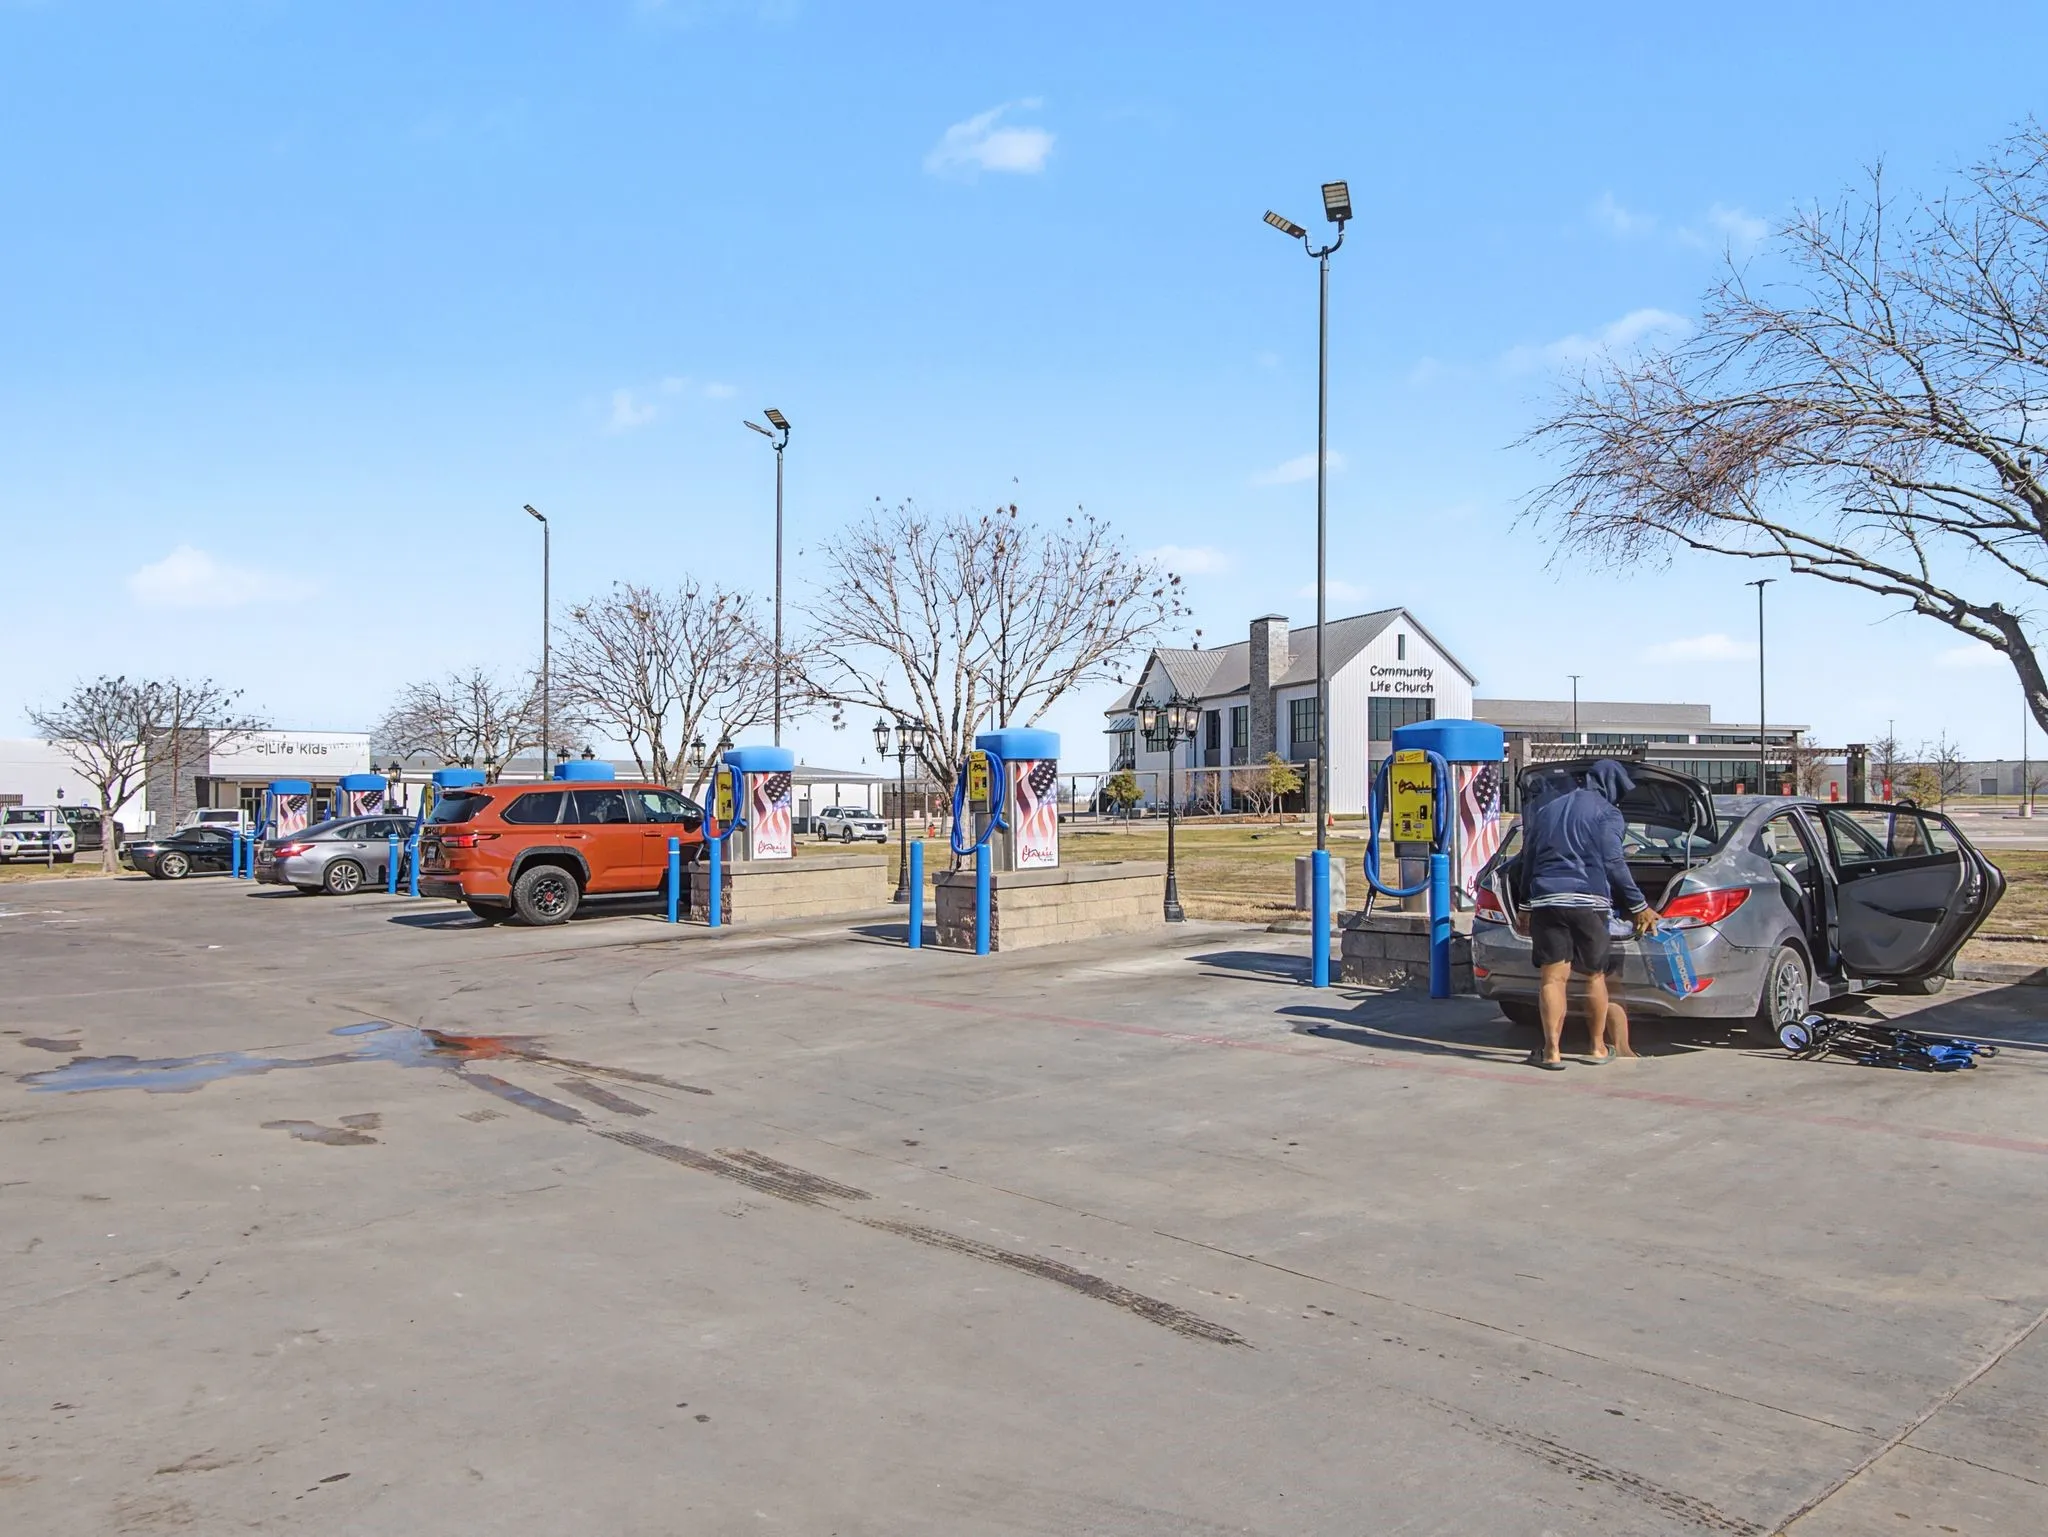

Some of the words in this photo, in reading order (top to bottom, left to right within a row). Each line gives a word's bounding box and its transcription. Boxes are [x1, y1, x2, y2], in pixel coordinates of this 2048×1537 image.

[1369, 664, 1434, 680] Community
[1370, 680, 1391, 692] Life
[1394, 681, 1434, 693] Church
[299, 743, 328, 755] Kids
